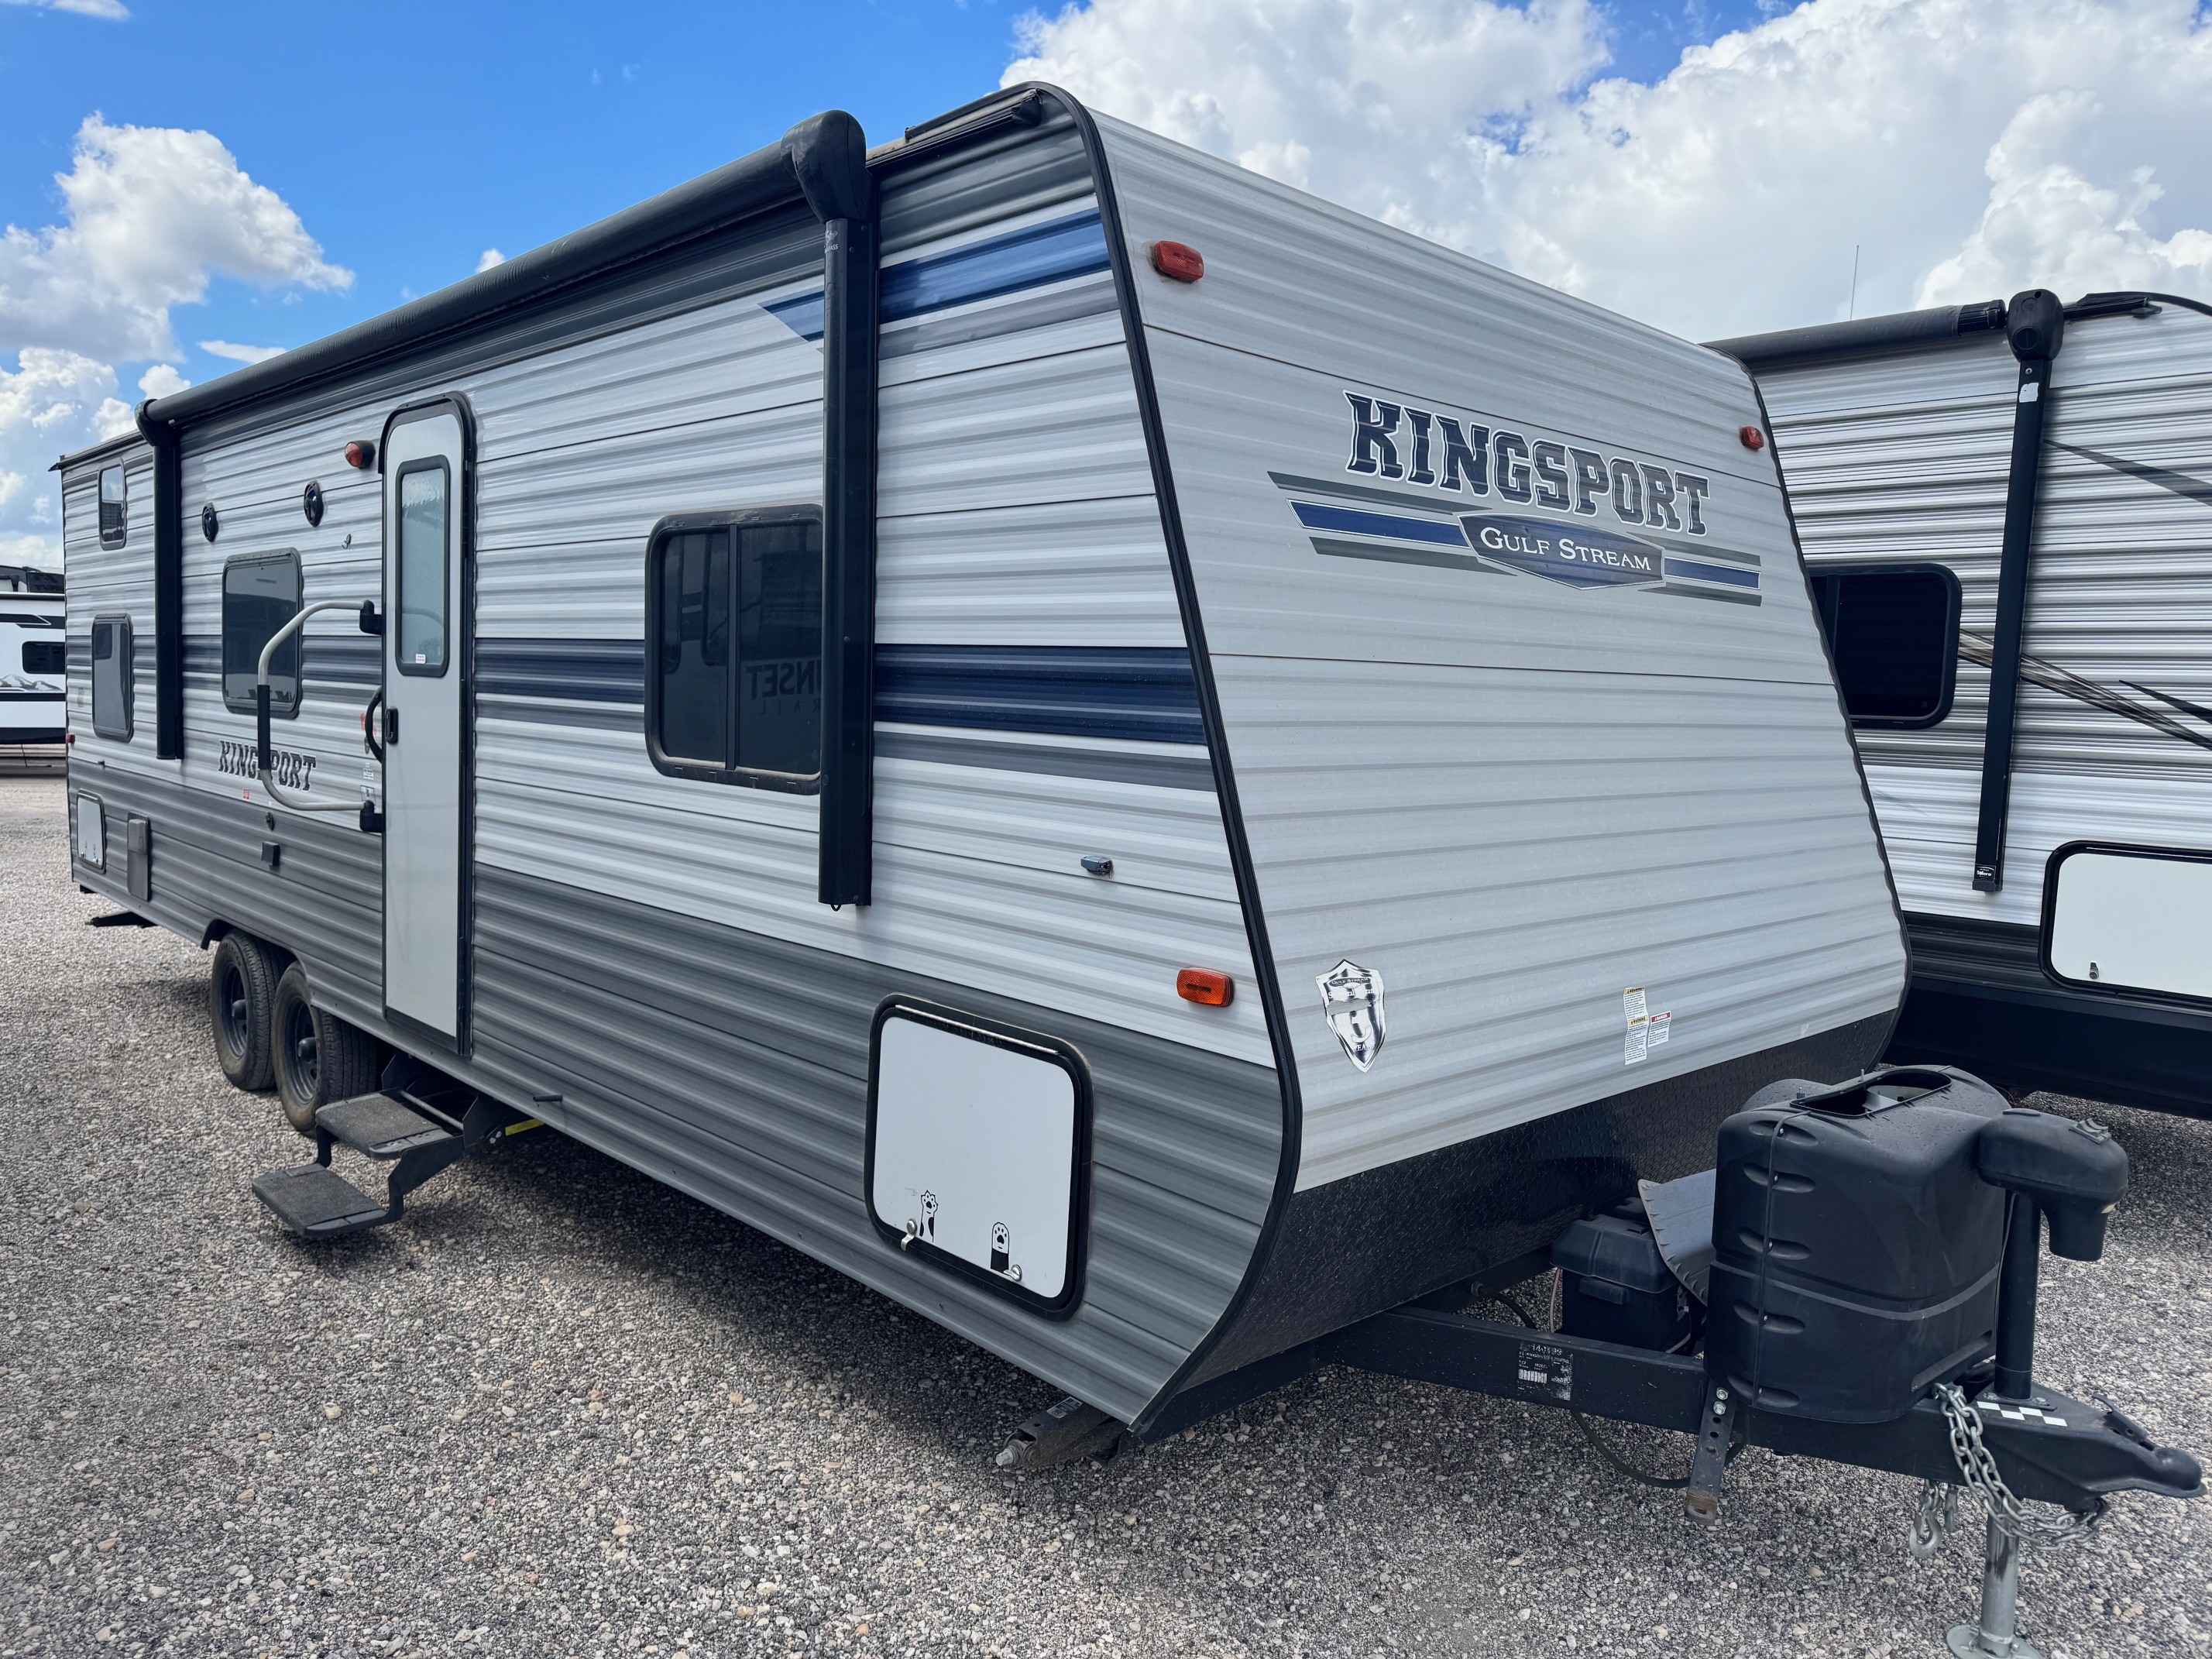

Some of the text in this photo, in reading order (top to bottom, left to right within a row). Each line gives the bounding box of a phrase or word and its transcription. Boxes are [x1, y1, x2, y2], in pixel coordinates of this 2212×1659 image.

[1343, 390, 1710, 537] KINGSPORT
[1480, 527, 1651, 571] GULF STREAM
[218, 740, 317, 792] KINGPORT
